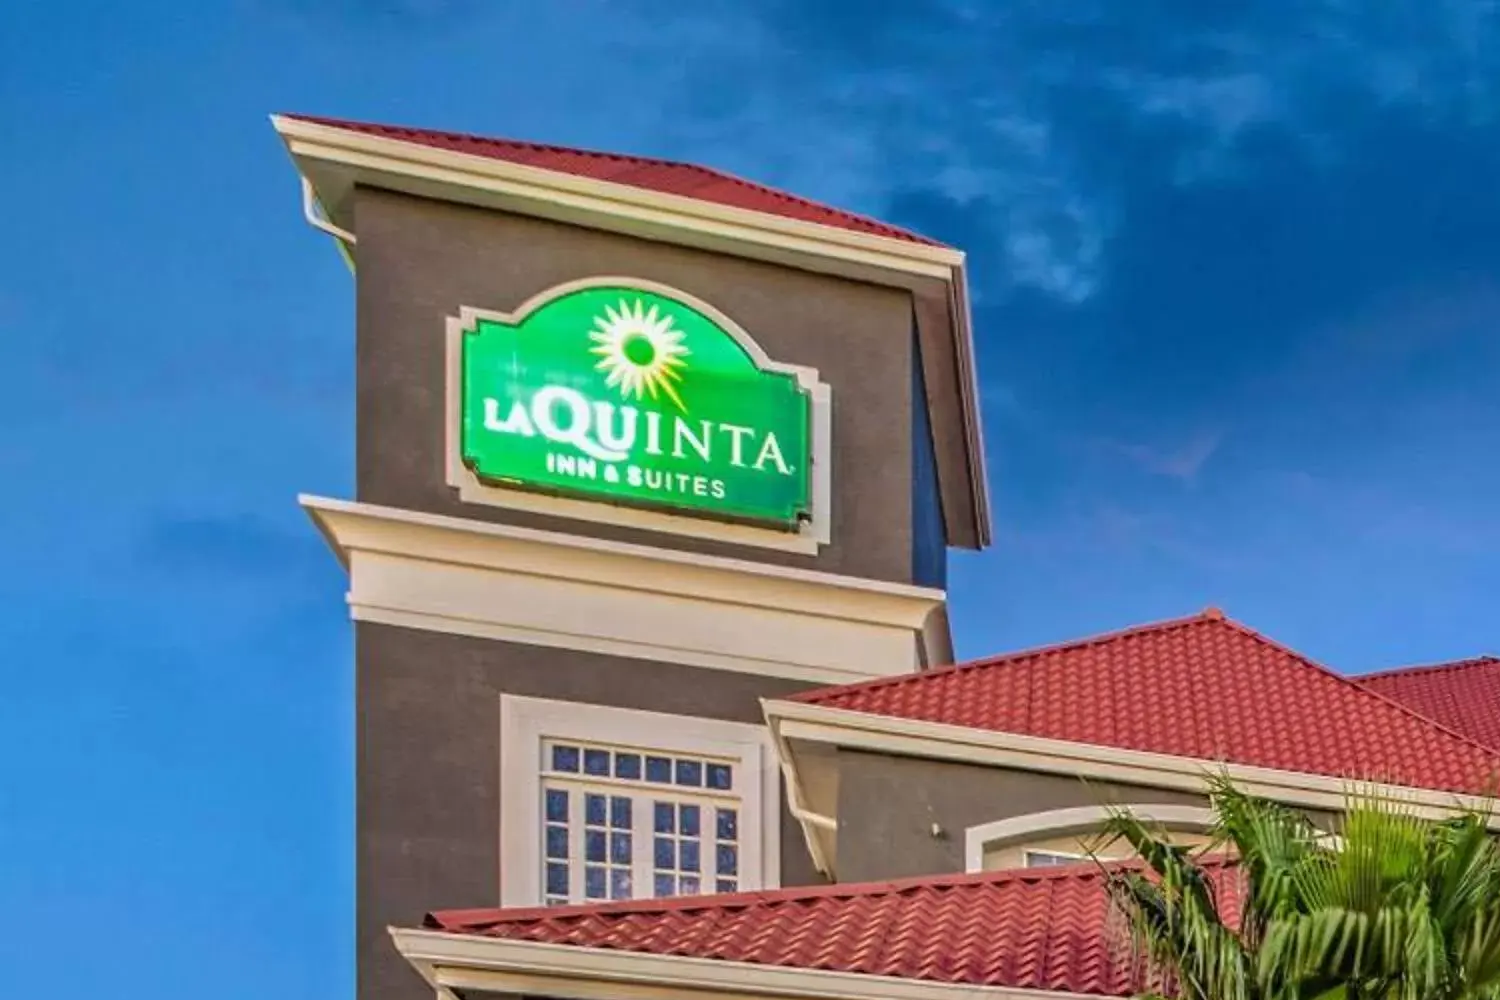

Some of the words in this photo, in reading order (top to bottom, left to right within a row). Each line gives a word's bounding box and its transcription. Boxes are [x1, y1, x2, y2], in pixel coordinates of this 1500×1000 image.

[483, 397, 535, 437] LA
[531, 384, 791, 476] QUINTA
[546, 452, 598, 480] INN
[603, 463, 620, 483] &
[626, 464, 726, 499] SUITES
